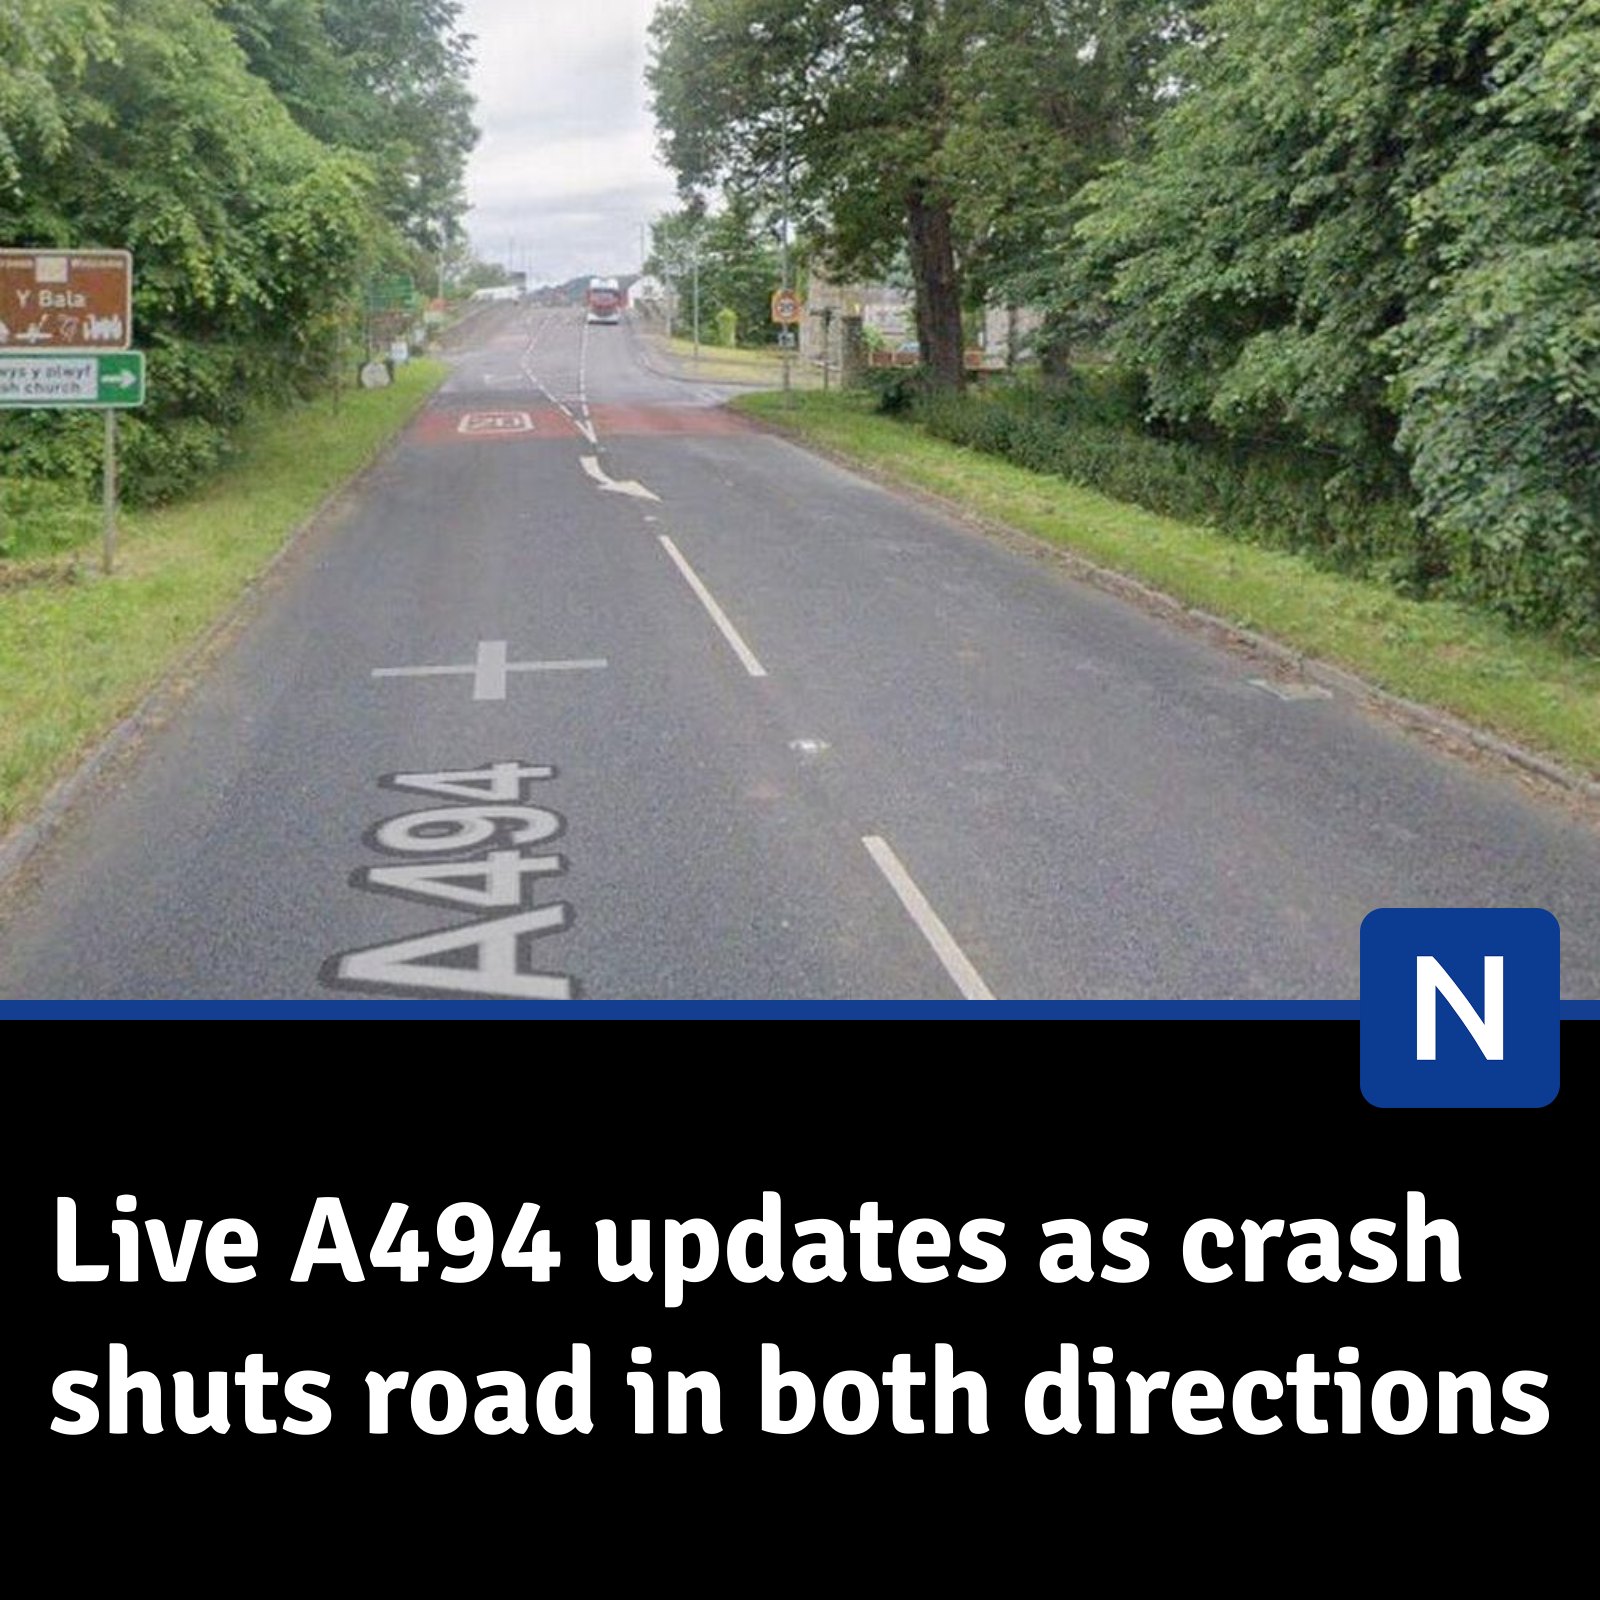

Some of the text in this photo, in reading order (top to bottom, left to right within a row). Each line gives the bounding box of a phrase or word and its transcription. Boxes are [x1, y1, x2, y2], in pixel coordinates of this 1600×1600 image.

[16, 289, 86, 308] Y Bala
[24, 381, 80, 394] church
